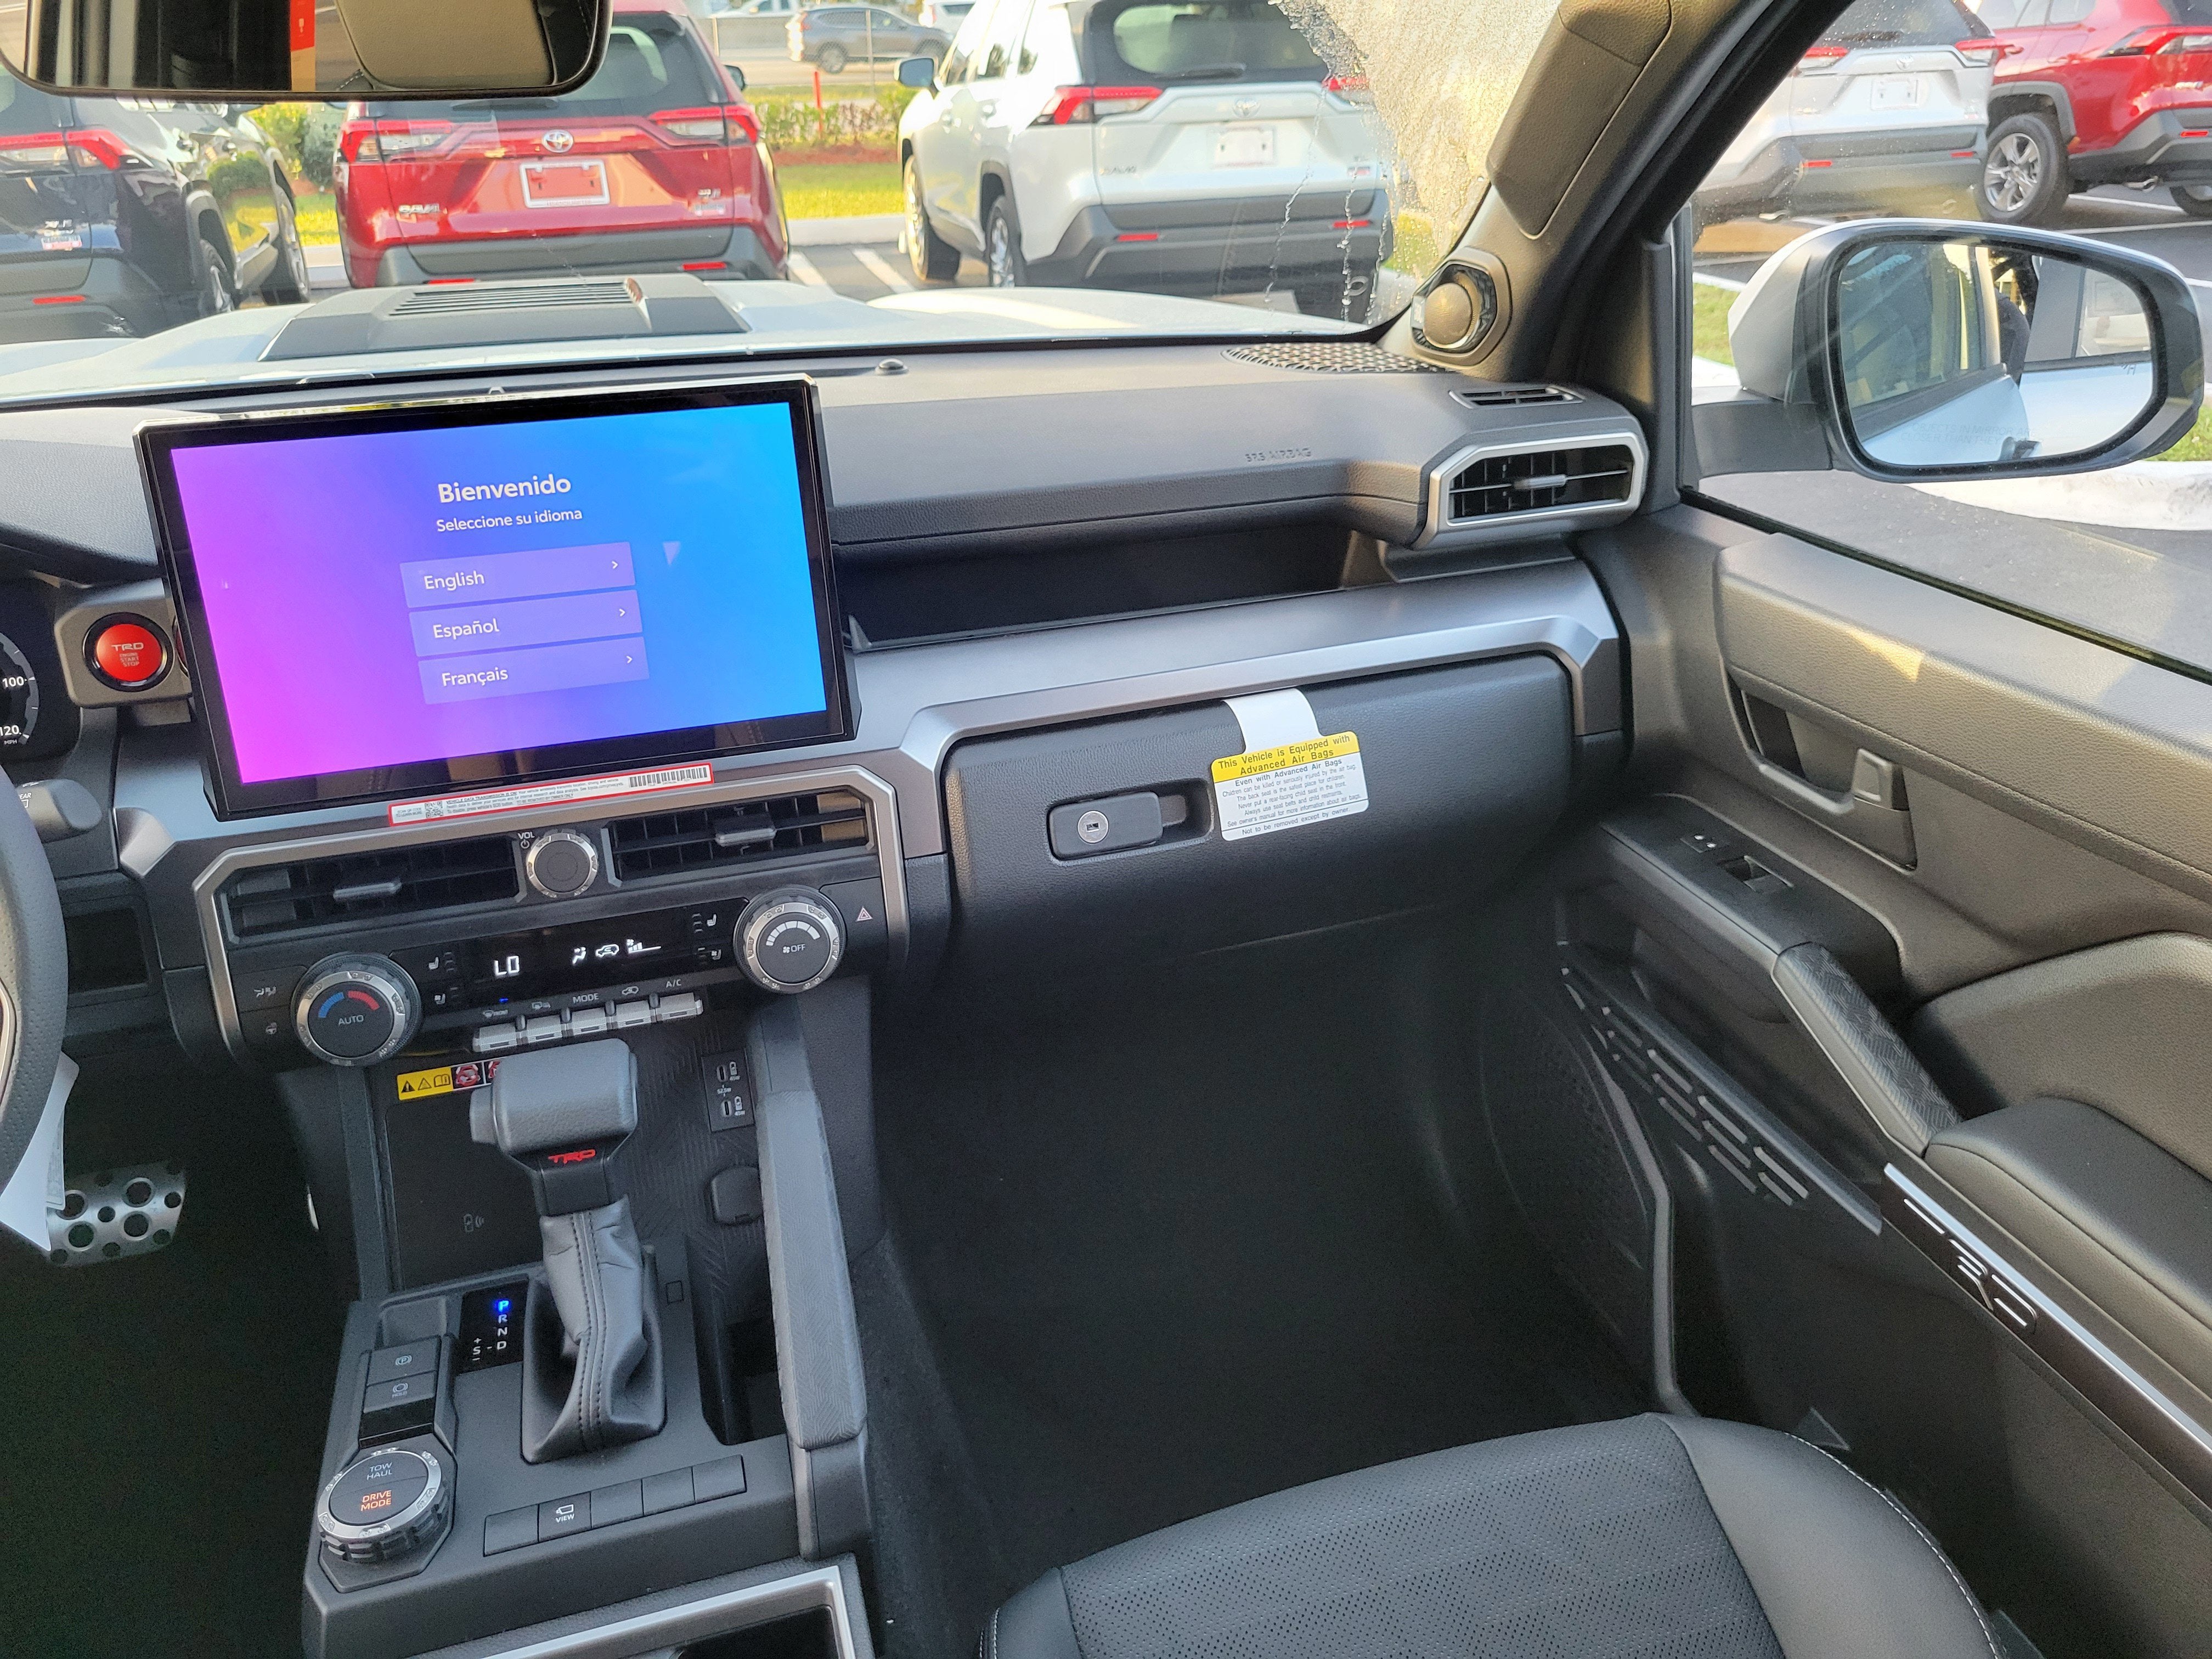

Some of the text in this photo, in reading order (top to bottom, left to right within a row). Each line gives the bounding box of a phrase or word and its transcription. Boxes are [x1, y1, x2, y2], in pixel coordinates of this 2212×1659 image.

[1913, 423, 1956, 433] OBJECTS
[1971, 425, 2013, 435] MIRROR
[438, 473, 572, 503] Bienvenido
[436, 509, 583, 532] Seleccione su idioma
[424, 570, 485, 591] English
[433, 618, 500, 640] Español
[111, 642, 144, 651] TRD
[2, 676, 25, 687] 100
[442, 667, 509, 686] Français
[1217, 735, 1350, 769] This Vehicle is Equipped with
[1240, 749, 1334, 776] Advanced Air Bags
[1235, 778, 1252, 787] Even
[1274, 765, 1308, 778] Advanced
[1222, 789, 1242, 797] Children
[1274, 817, 1299, 828] removed
[1301, 813, 1319, 822] except
[517, 831, 535, 840] VOL
[791, 944, 805, 952] OFF
[665, 979, 682, 988] A/C
[573, 993, 599, 1003] MODE
[338, 1014, 364, 1026] AUTO
[548, 1149, 596, 1164] TRD
[498, 1300, 509, 1312] P
[498, 1314, 508, 1324] R
[497, 1327, 508, 1337] N
[472, 1346, 481, 1355] S
[496, 1341, 507, 1350] D
[370, 1462, 392, 1472] TOW
[366, 1469, 393, 1480] HAUL
[362, 1489, 392, 1503] DRIVE
[360, 1498, 392, 1511] MODE
[555, 1513, 575, 1523] VIEW
